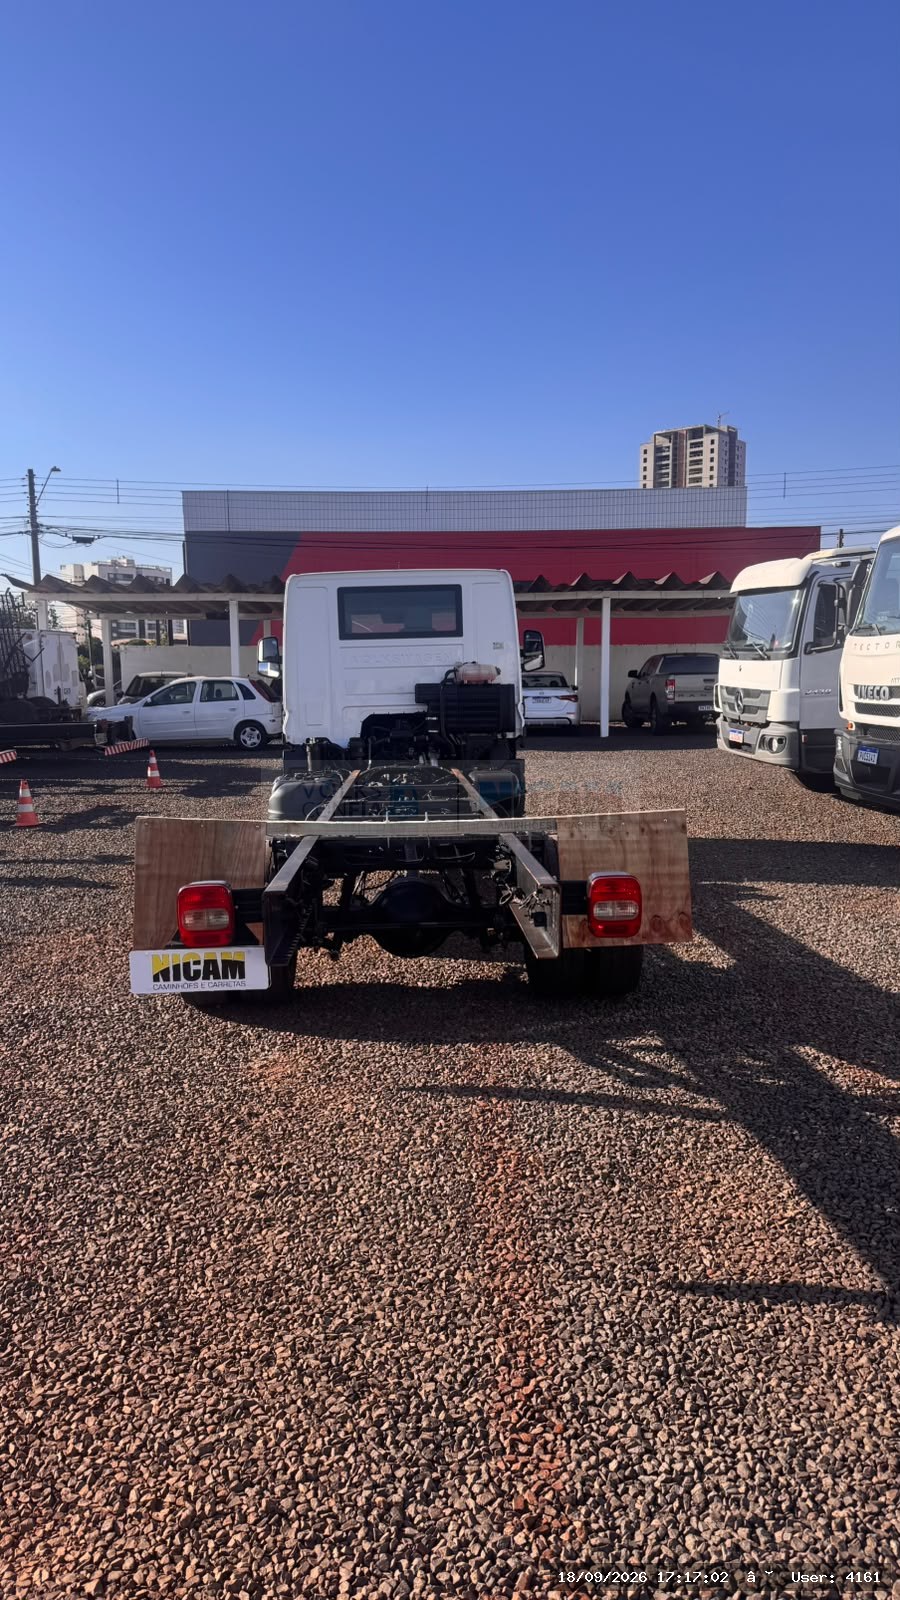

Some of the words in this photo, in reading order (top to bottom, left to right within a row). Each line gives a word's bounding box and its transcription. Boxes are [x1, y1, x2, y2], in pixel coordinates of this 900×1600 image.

[857, 685, 890, 700] IVECO
[152, 951, 246, 983] NICAM
[207, 980, 246, 988] CARRETAS
